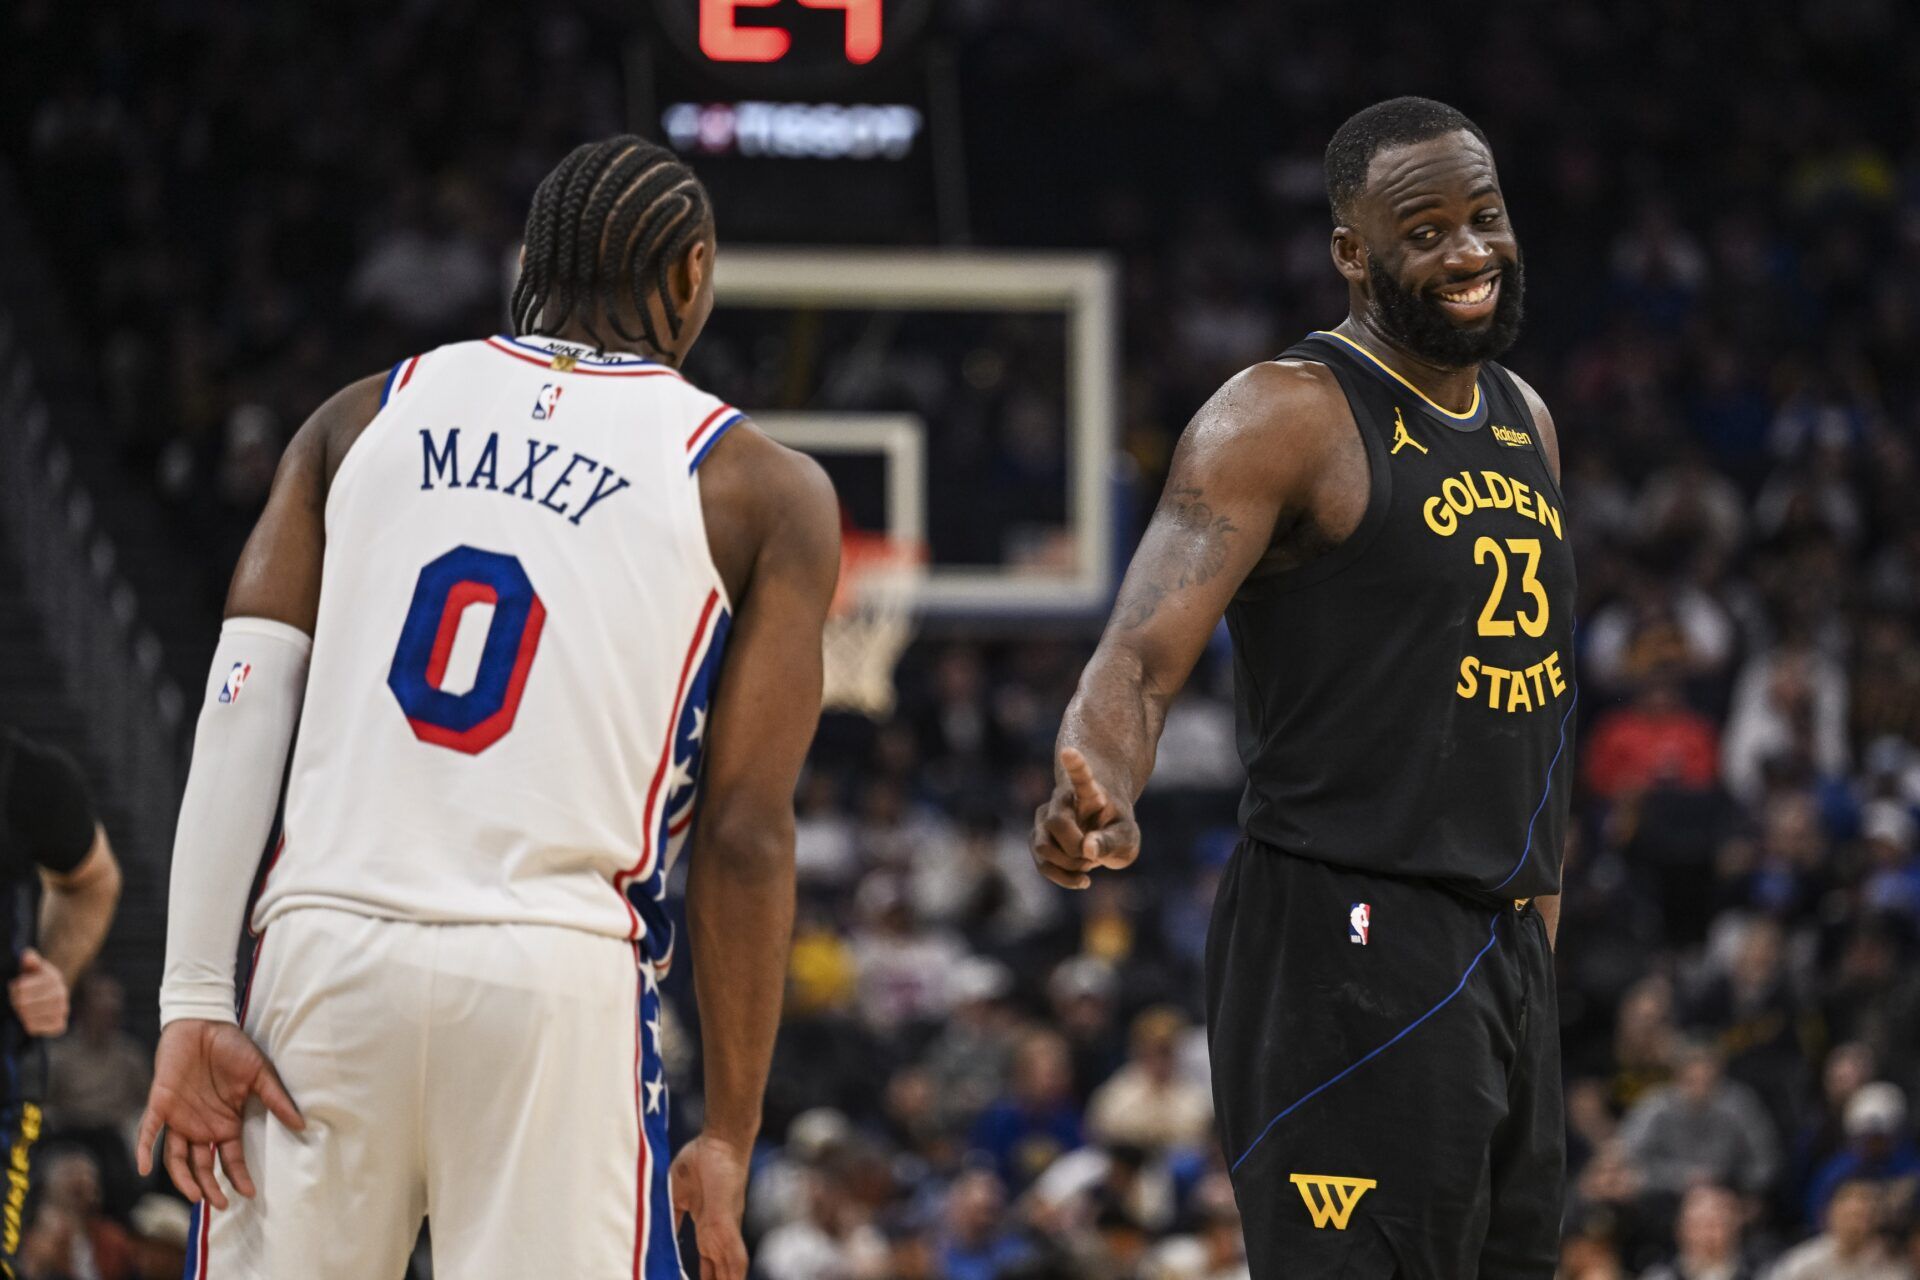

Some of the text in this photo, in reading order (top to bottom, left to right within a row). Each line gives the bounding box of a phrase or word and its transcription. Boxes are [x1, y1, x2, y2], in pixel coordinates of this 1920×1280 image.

[545, 342, 585, 358] NIKE
[1491, 425, 1532, 444] Rakuten
[419, 428, 630, 526] MAXEY
[1423, 471, 1562, 540] GOLDEN
[1474, 536, 1549, 638] 23
[387, 544, 547, 756] 0
[1456, 651, 1566, 713] STATE
